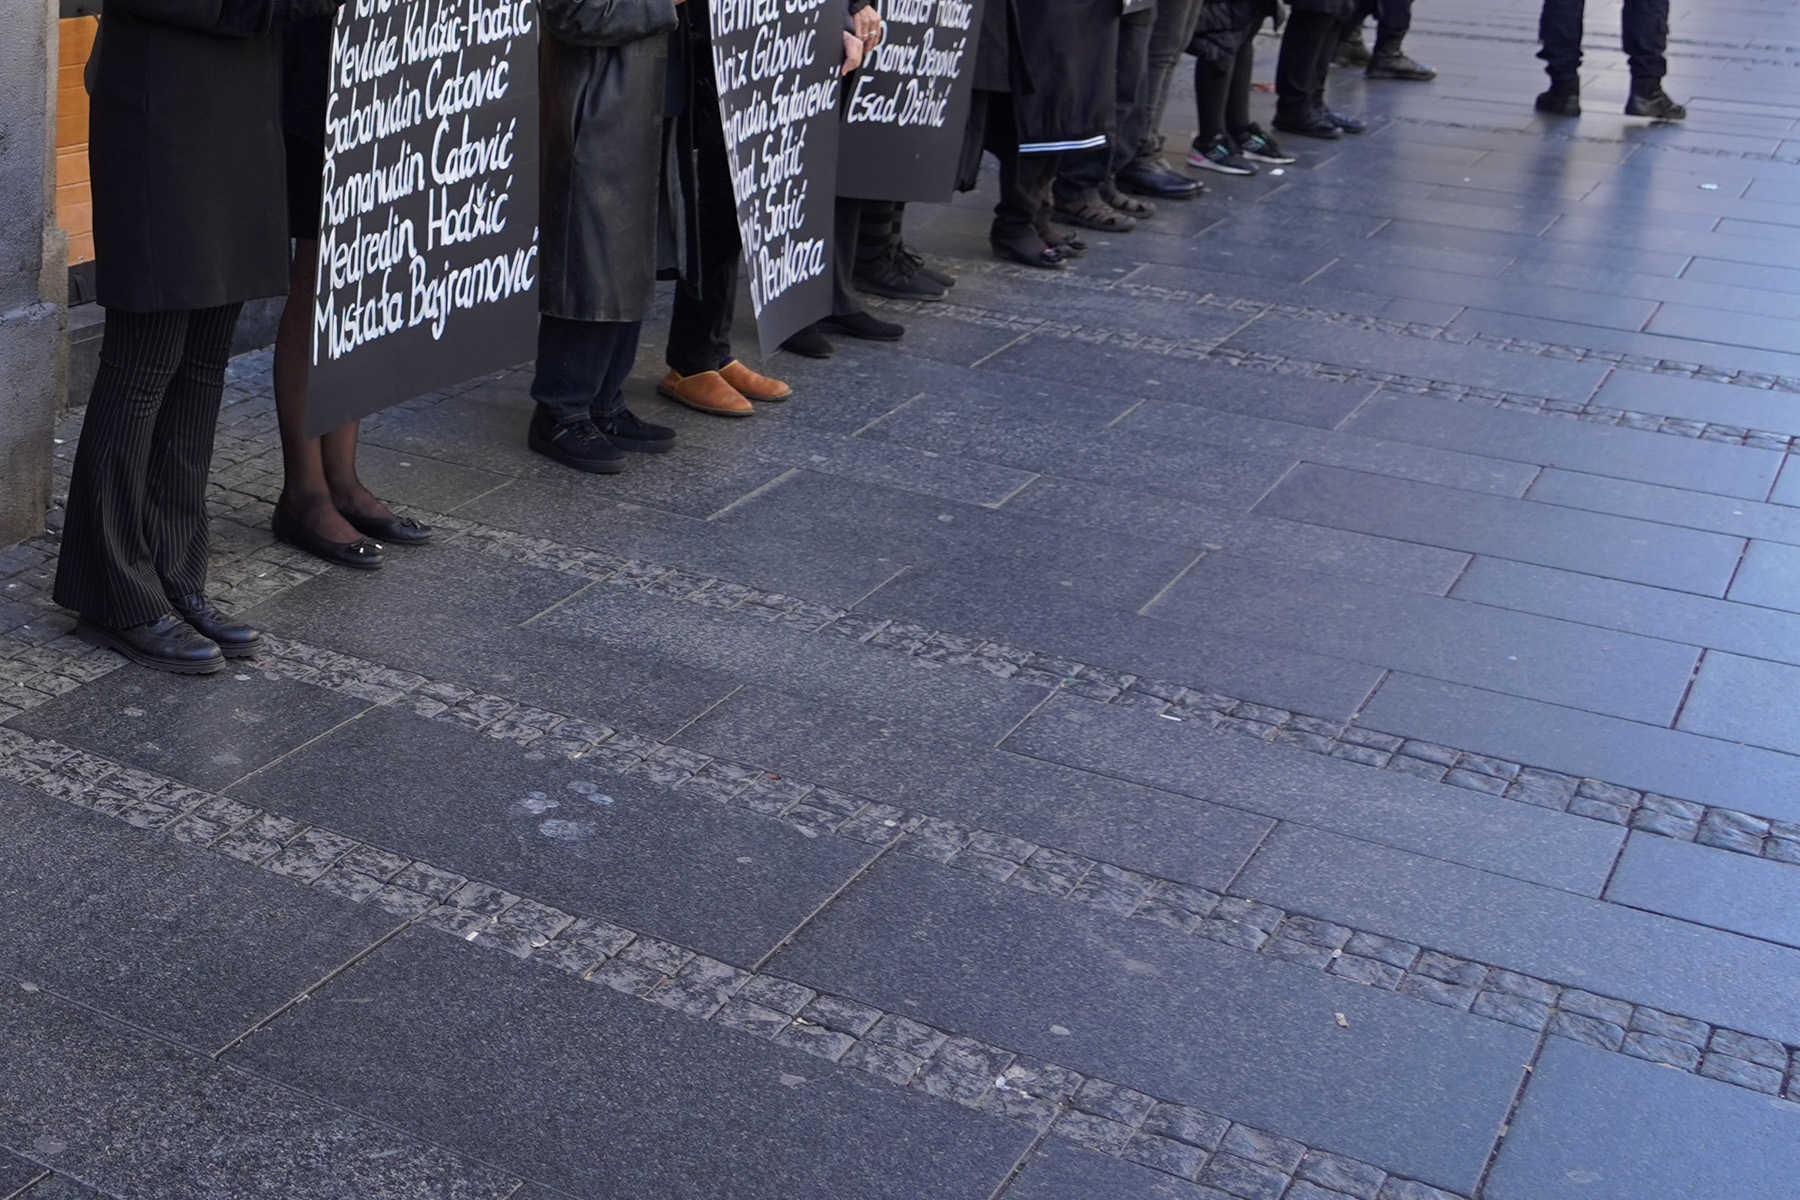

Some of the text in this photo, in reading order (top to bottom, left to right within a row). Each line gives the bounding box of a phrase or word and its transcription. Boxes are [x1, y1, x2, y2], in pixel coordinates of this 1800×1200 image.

[329, 17, 399, 94] Mevlida
[751, 10, 820, 81] Gibović
[863, 20, 967, 89] Ramiz Begović
[325, 74, 422, 160] Sabahudin
[847, 75, 903, 124] Esad
[320, 140, 425, 229] Ramahudin
[316, 174, 513, 296] Medredin Hodžić
[759, 231, 825, 305] Pecikoza
[313, 226, 539, 367] Mustafa Bajramović
